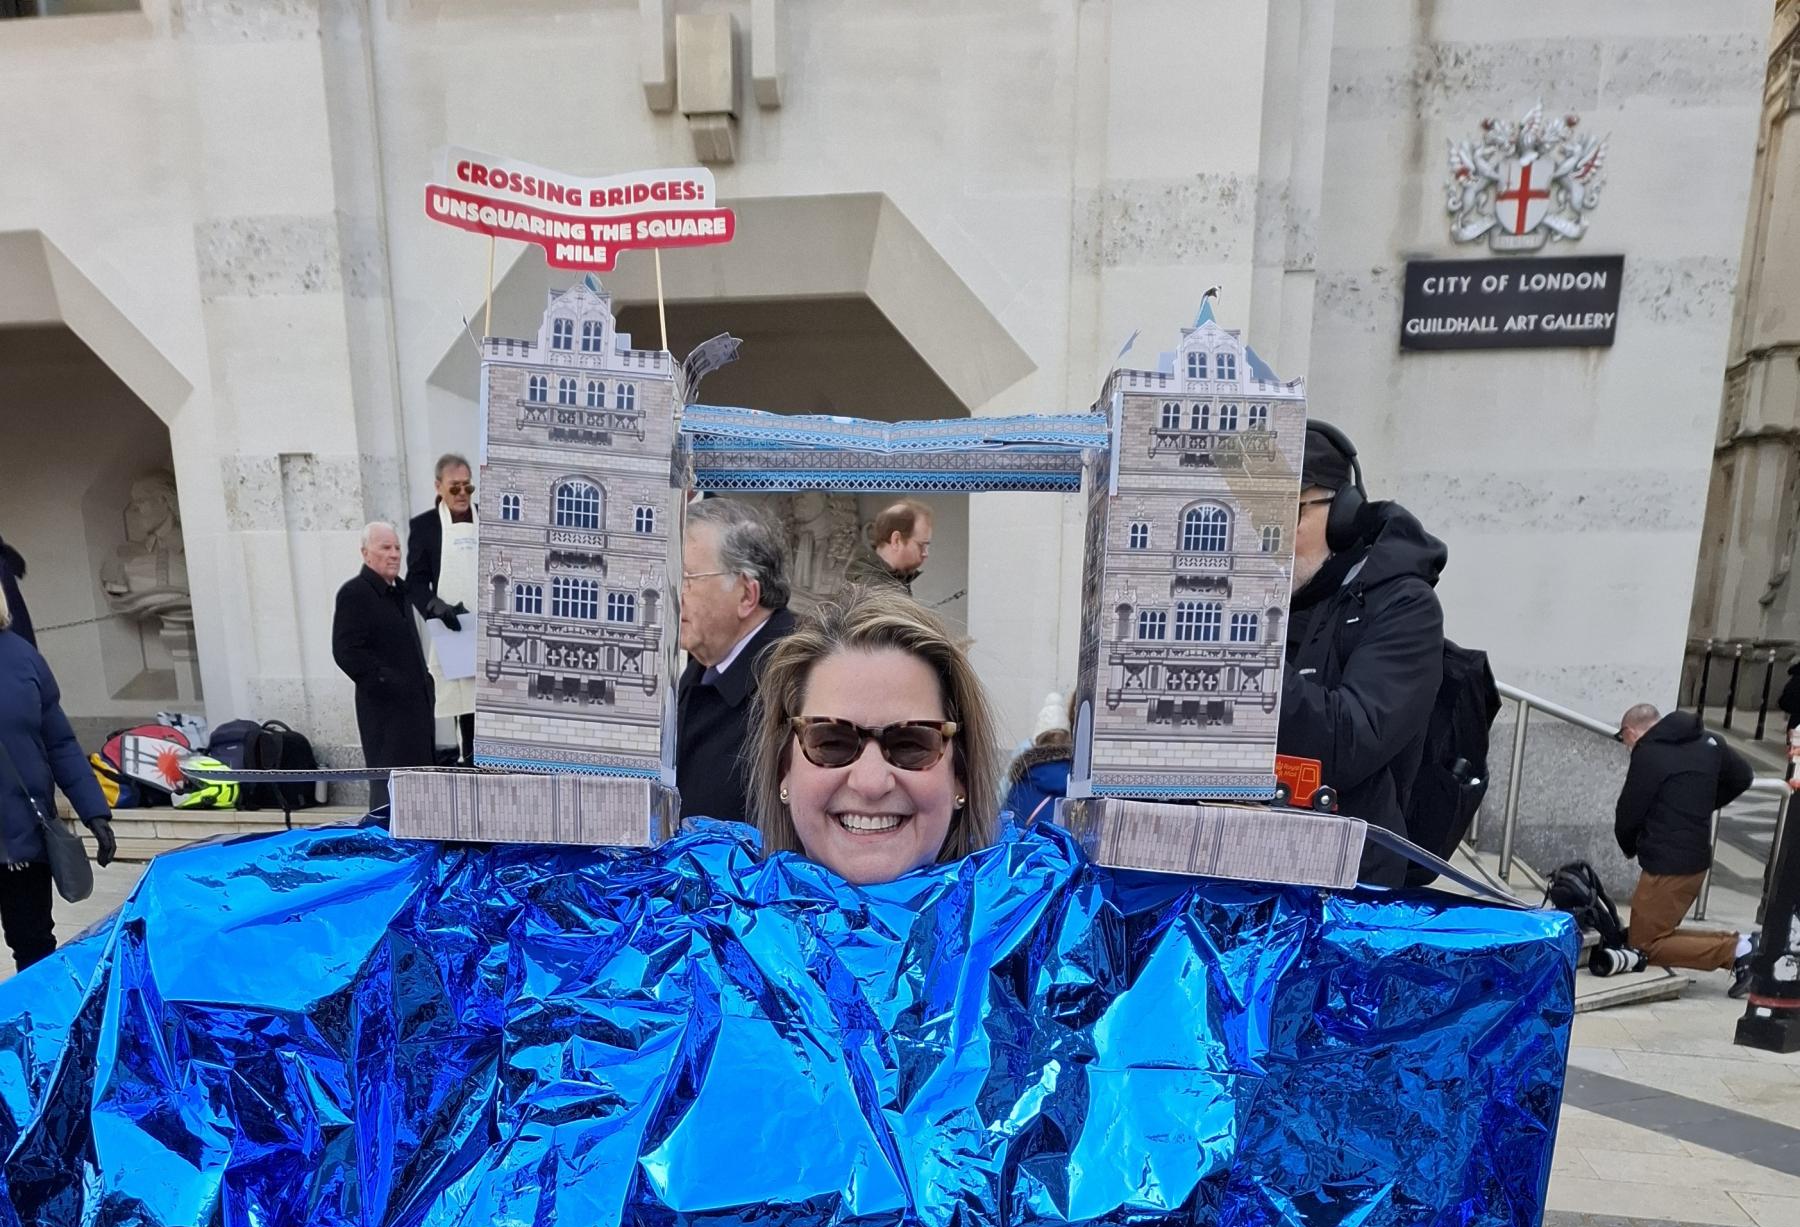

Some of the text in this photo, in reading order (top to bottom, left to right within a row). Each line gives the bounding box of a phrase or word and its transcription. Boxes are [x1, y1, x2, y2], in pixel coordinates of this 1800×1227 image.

[457, 160, 705, 208] CROSSING BRIDGES:
[433, 194, 726, 241] UNSQUARING THE SQUARE
[556, 243, 607, 263] MILE
[1422, 271, 1607, 294] CITY OF LONDON
[1405, 312, 1615, 334] GUILDHALL ART GALLERY
